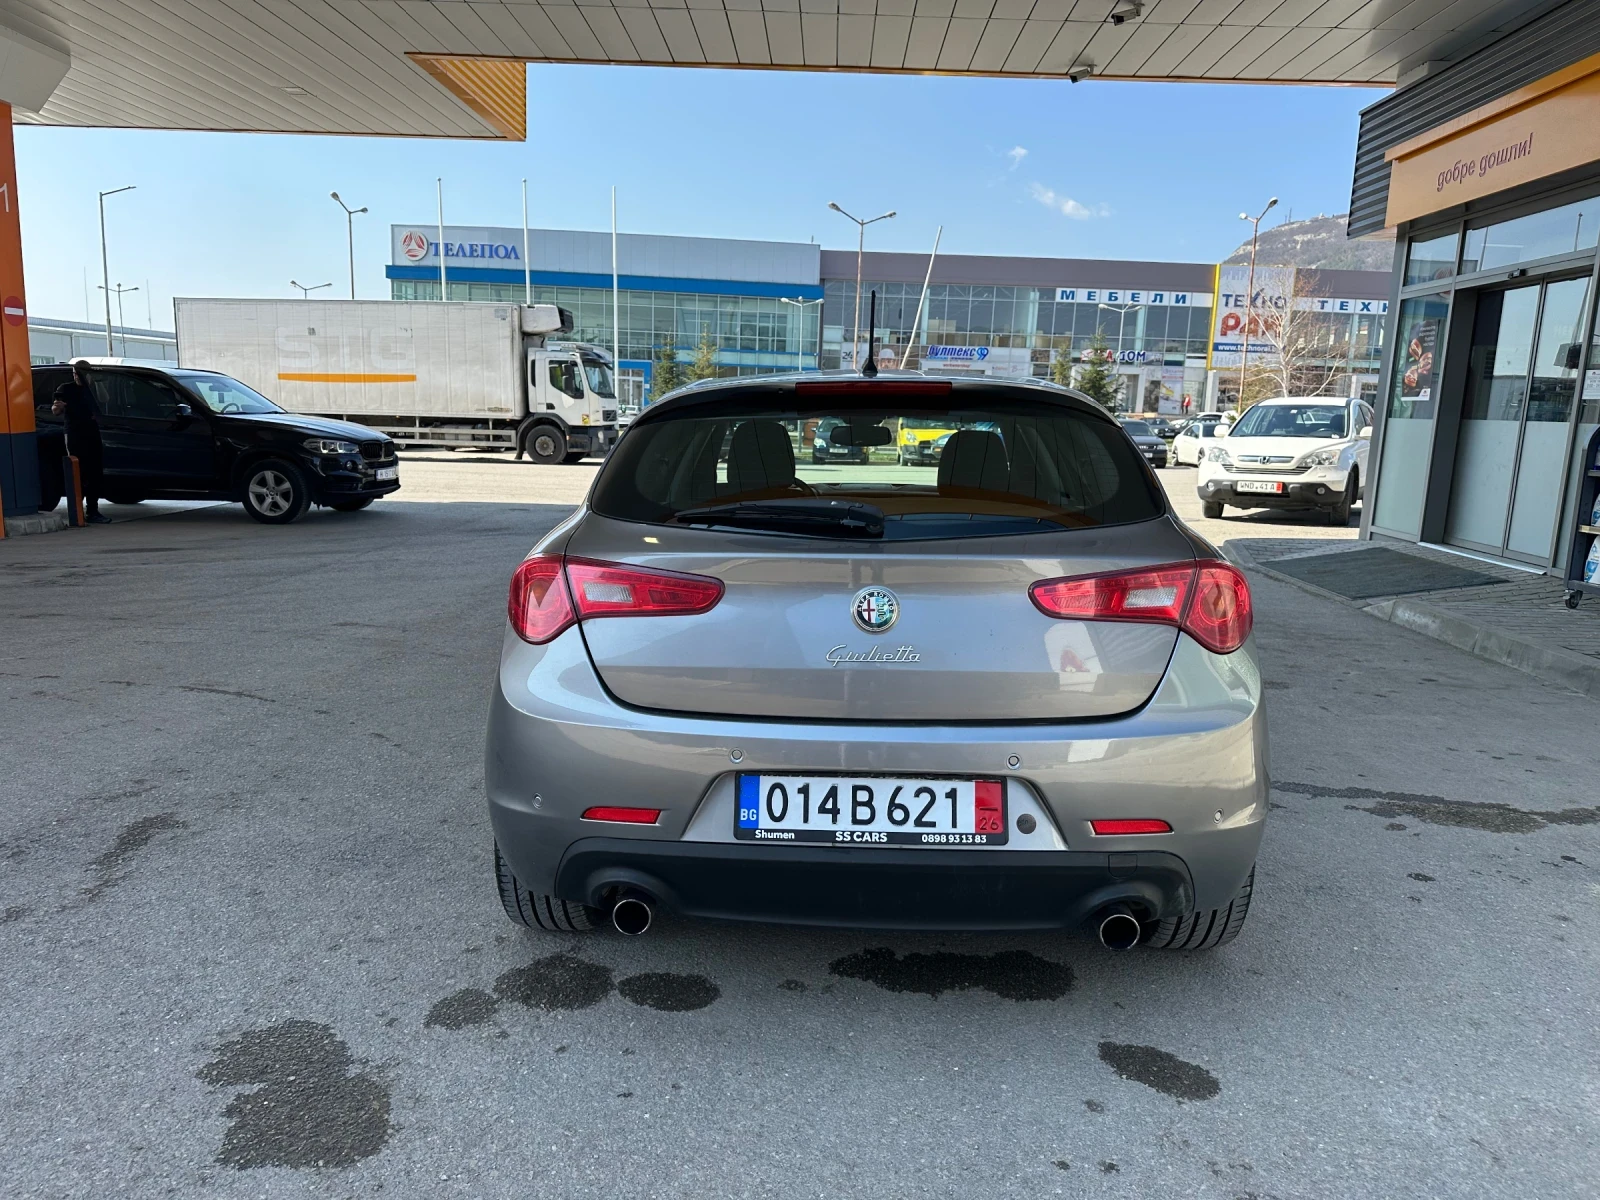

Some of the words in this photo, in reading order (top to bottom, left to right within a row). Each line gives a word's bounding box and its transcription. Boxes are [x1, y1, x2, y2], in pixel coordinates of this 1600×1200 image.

[1437, 159, 1476, 192] добре
[1479, 132, 1534, 177] дошли!
[429, 241, 520, 260] ТЕЛЕПОЛ
[1060, 289, 1187, 304] МЕБЕЛИ
[826, 644, 921, 667] Giulietta
[740, 808, 757, 821] BG
[979, 816, 999, 831] 26
[755, 829, 795, 840] Shumen
[835, 831, 851, 842] SS
[853, 832, 888, 842] CARS
[921, 834, 947, 843] 0898
[948, 834, 960, 843] 93
[961, 834, 973, 843] 13
[974, 834, 987, 843] 83
